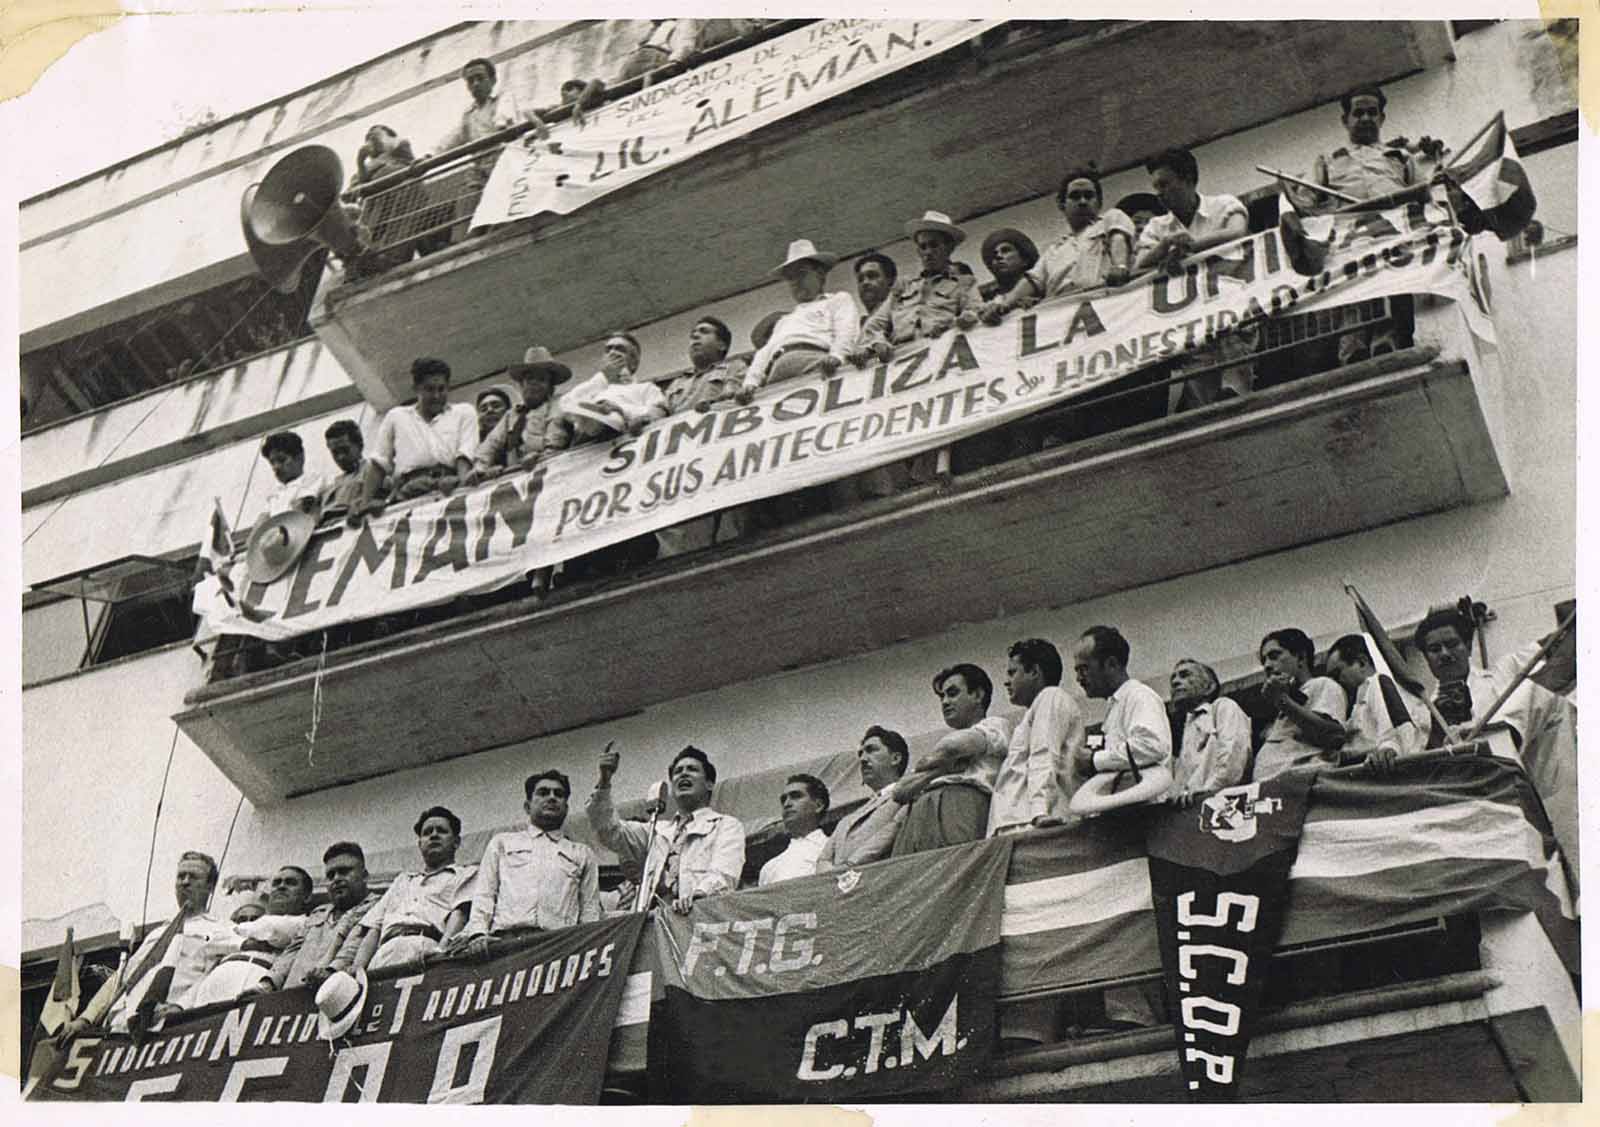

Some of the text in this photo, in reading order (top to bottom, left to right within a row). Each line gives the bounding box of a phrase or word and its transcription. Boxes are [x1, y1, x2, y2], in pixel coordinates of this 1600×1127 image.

[555, 481, 632, 538] POR
[640, 456, 702, 511] SUS
[712, 376, 1007, 486] ANTECEDENTES
[602, 334, 980, 475] SIMBOLIZA
[1019, 301, 1107, 357] LA
[53, 1029, 211, 1088] SINDICATO
[389, 943, 616, 1034] TRABAJADORES
[681, 912, 824, 976] F.T.G.
[1177, 891, 1260, 1091] S.C.O.P.
[797, 992, 968, 1081] C.T.M.
